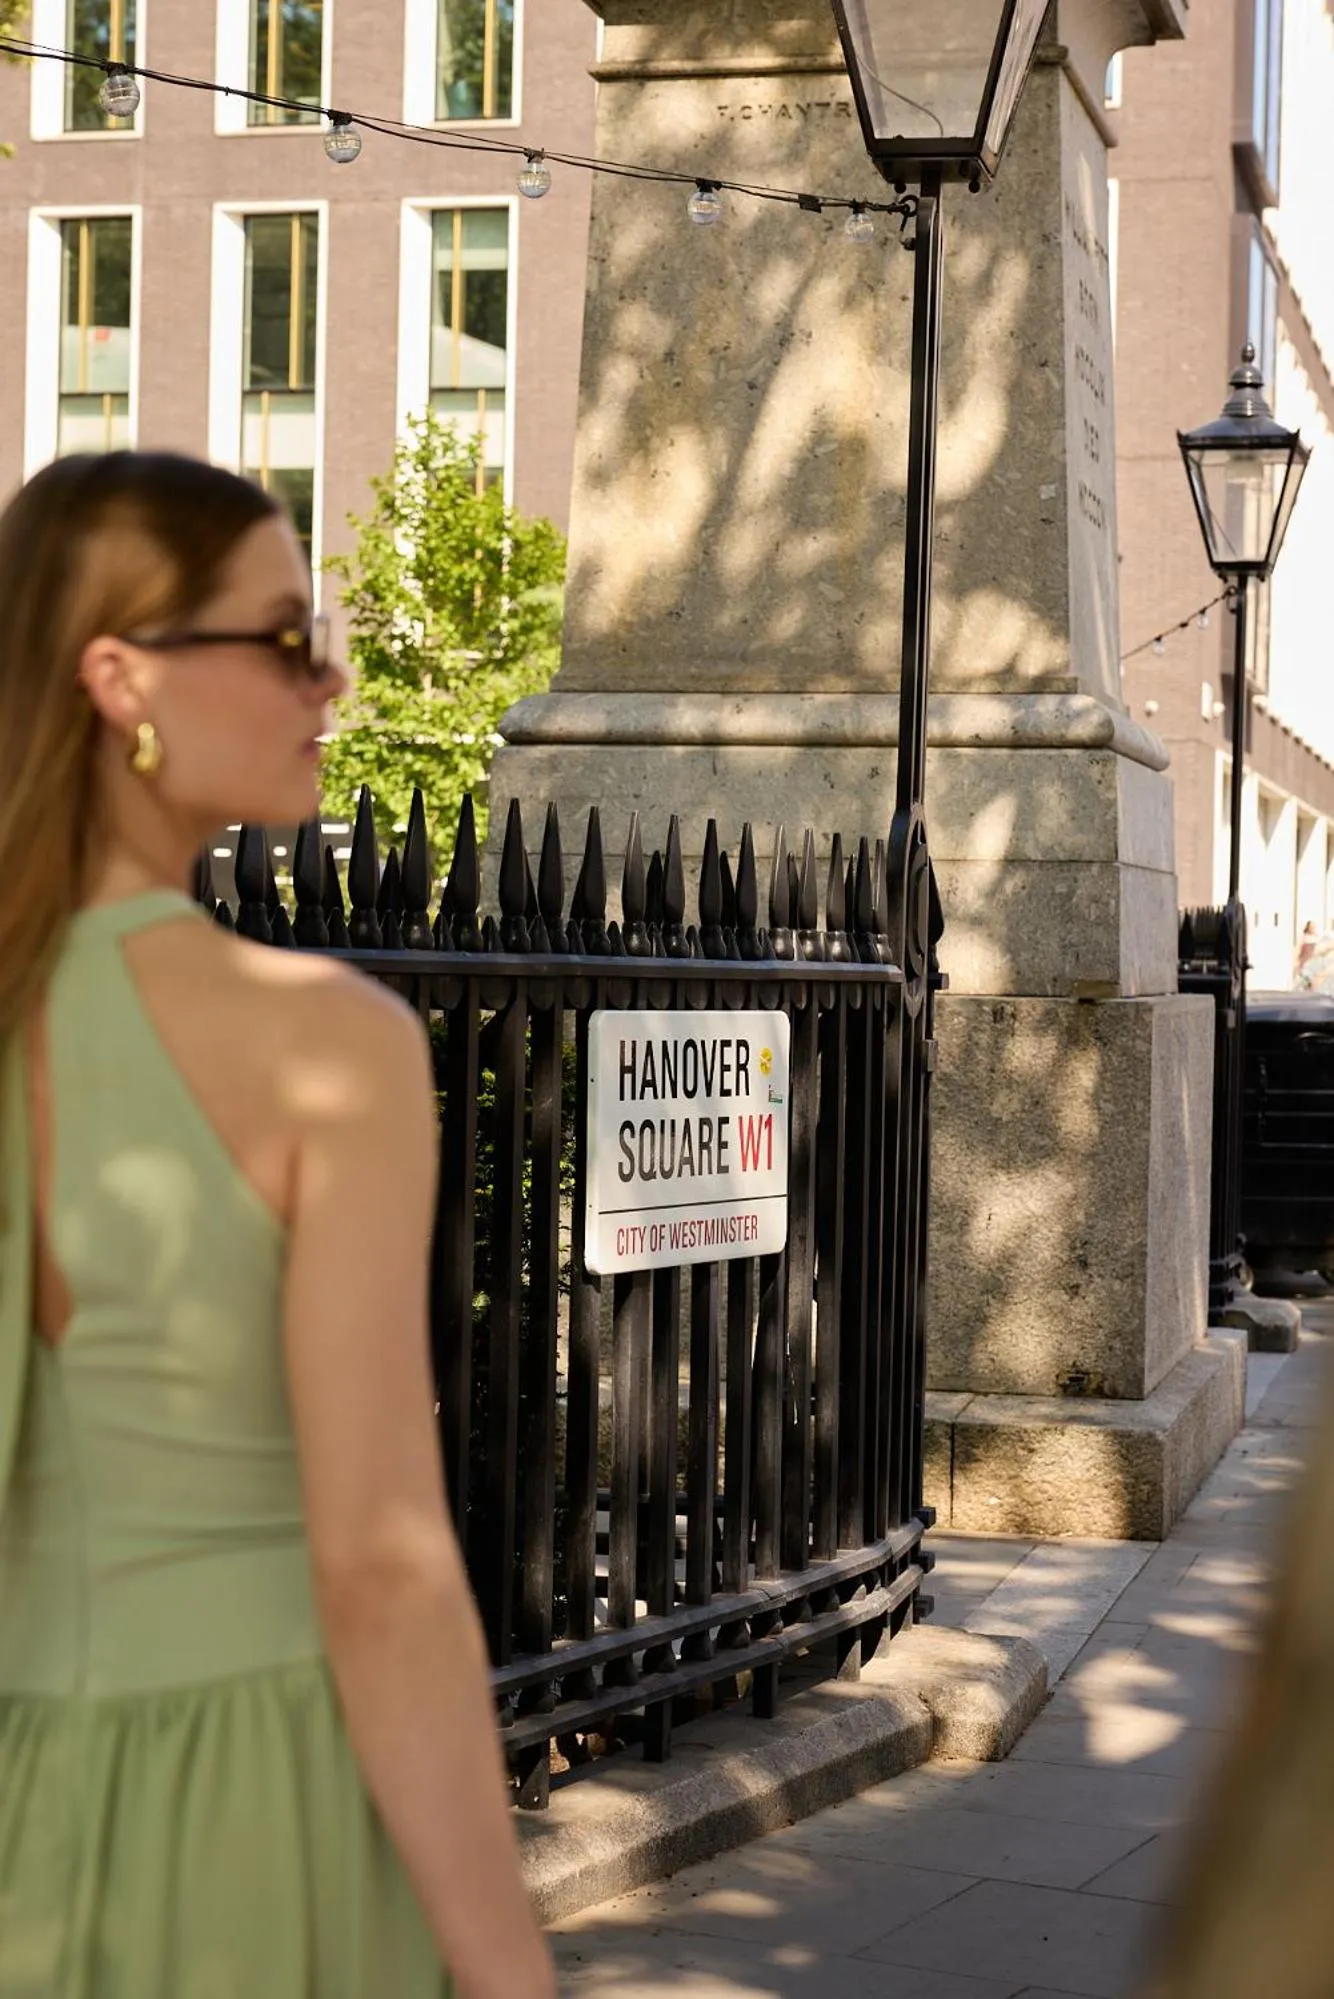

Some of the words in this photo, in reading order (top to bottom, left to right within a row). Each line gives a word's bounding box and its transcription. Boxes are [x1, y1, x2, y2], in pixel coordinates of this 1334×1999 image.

[619, 1038, 750, 1101] HANOVER
[618, 1116, 730, 1183] SQUARE
[738, 1113, 773, 1172] W1
[616, 1225, 647, 1256] CITY
[650, 1223, 665, 1252] OF
[669, 1214, 758, 1248] WESTMINSTER
